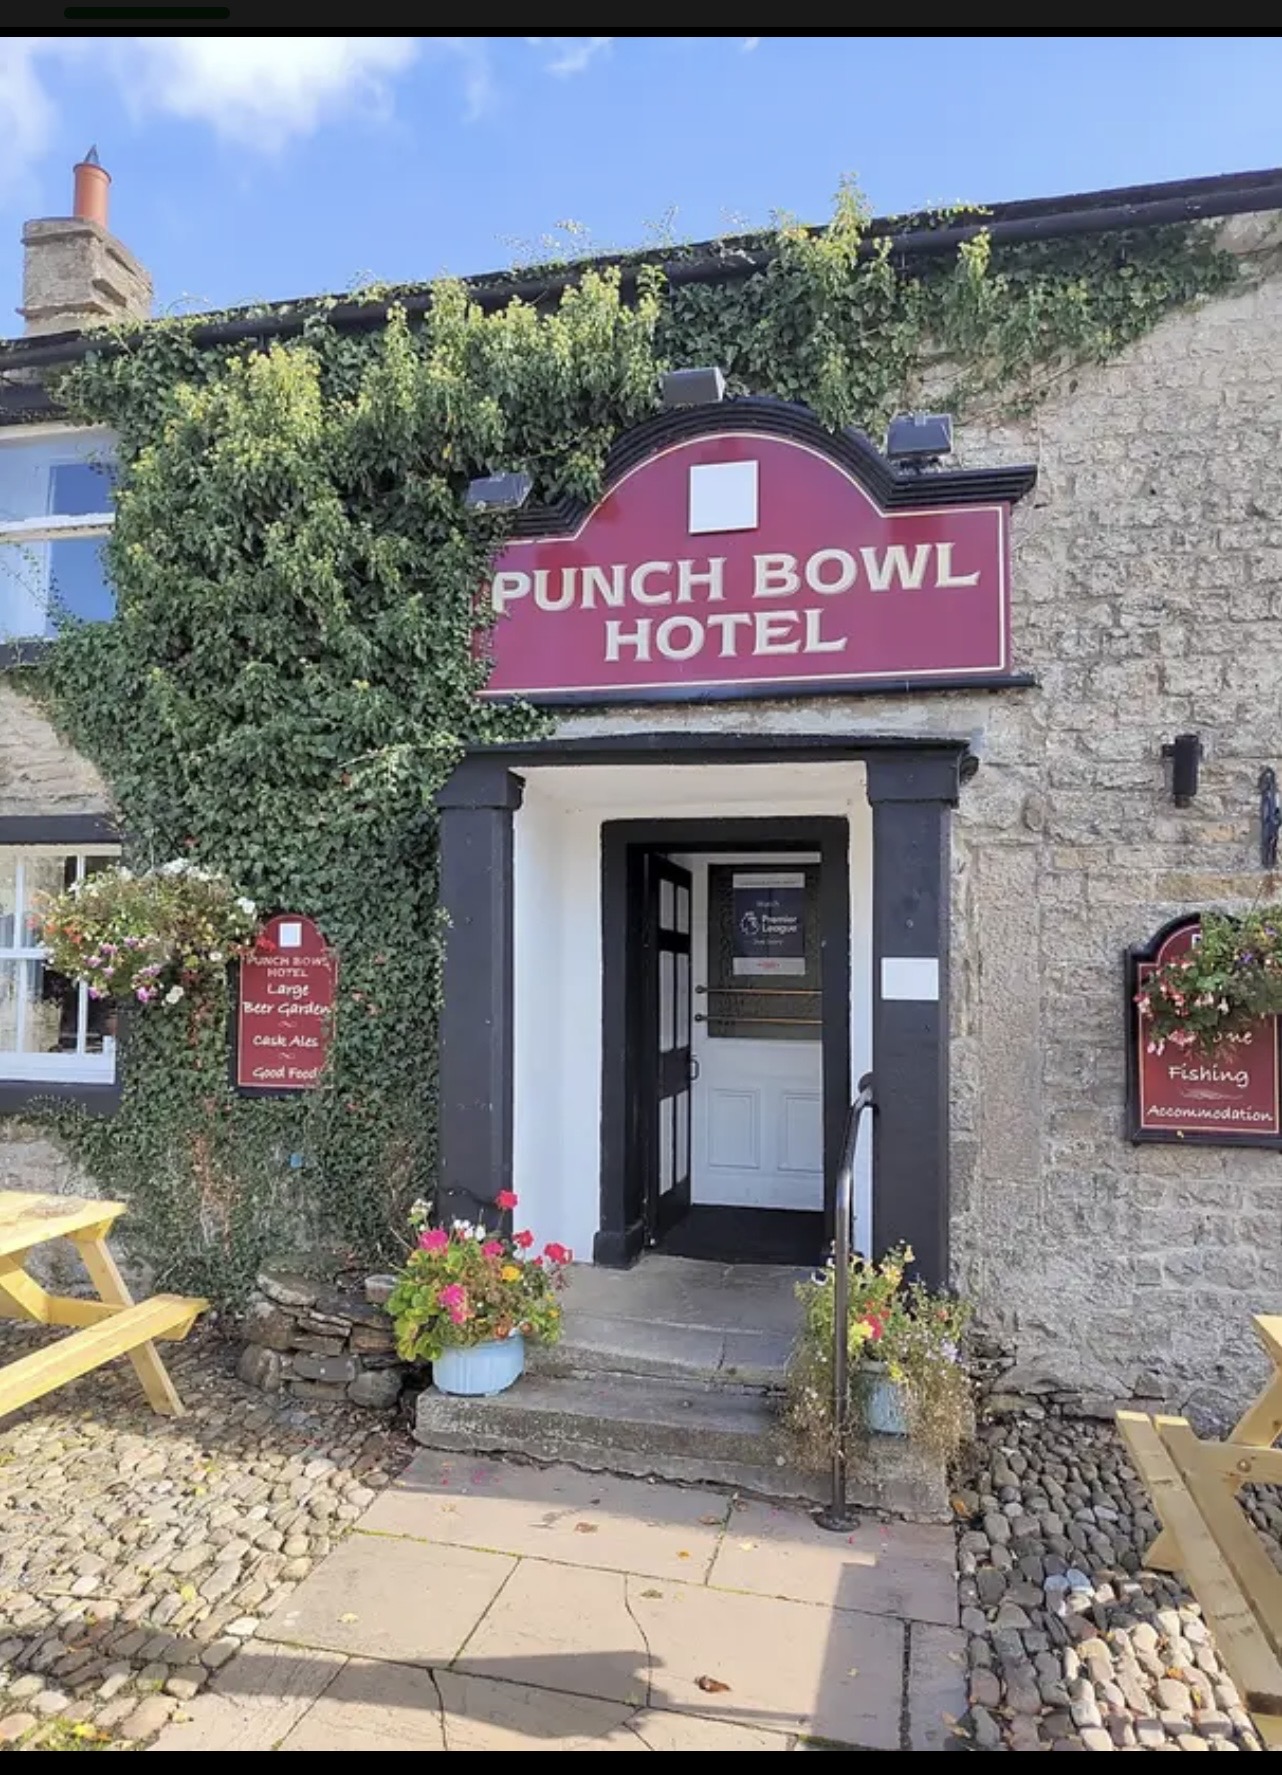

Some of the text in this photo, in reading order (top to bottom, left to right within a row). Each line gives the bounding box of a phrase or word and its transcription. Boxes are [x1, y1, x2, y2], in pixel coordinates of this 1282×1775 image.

[491, 542, 981, 614] PUNCH BOWL
[604, 608, 848, 662] HOTEL
[267, 968, 308, 977] HOTEL
[267, 983, 310, 1000] Large
[243, 1001, 331, 1017] Beer Garden
[252, 1035, 319, 1047] Cask Ales
[252, 1065, 318, 1080] Good Food
[1168, 1063, 1249, 1088] Fishing
[1147, 1105, 1273, 1121] Accommodation
